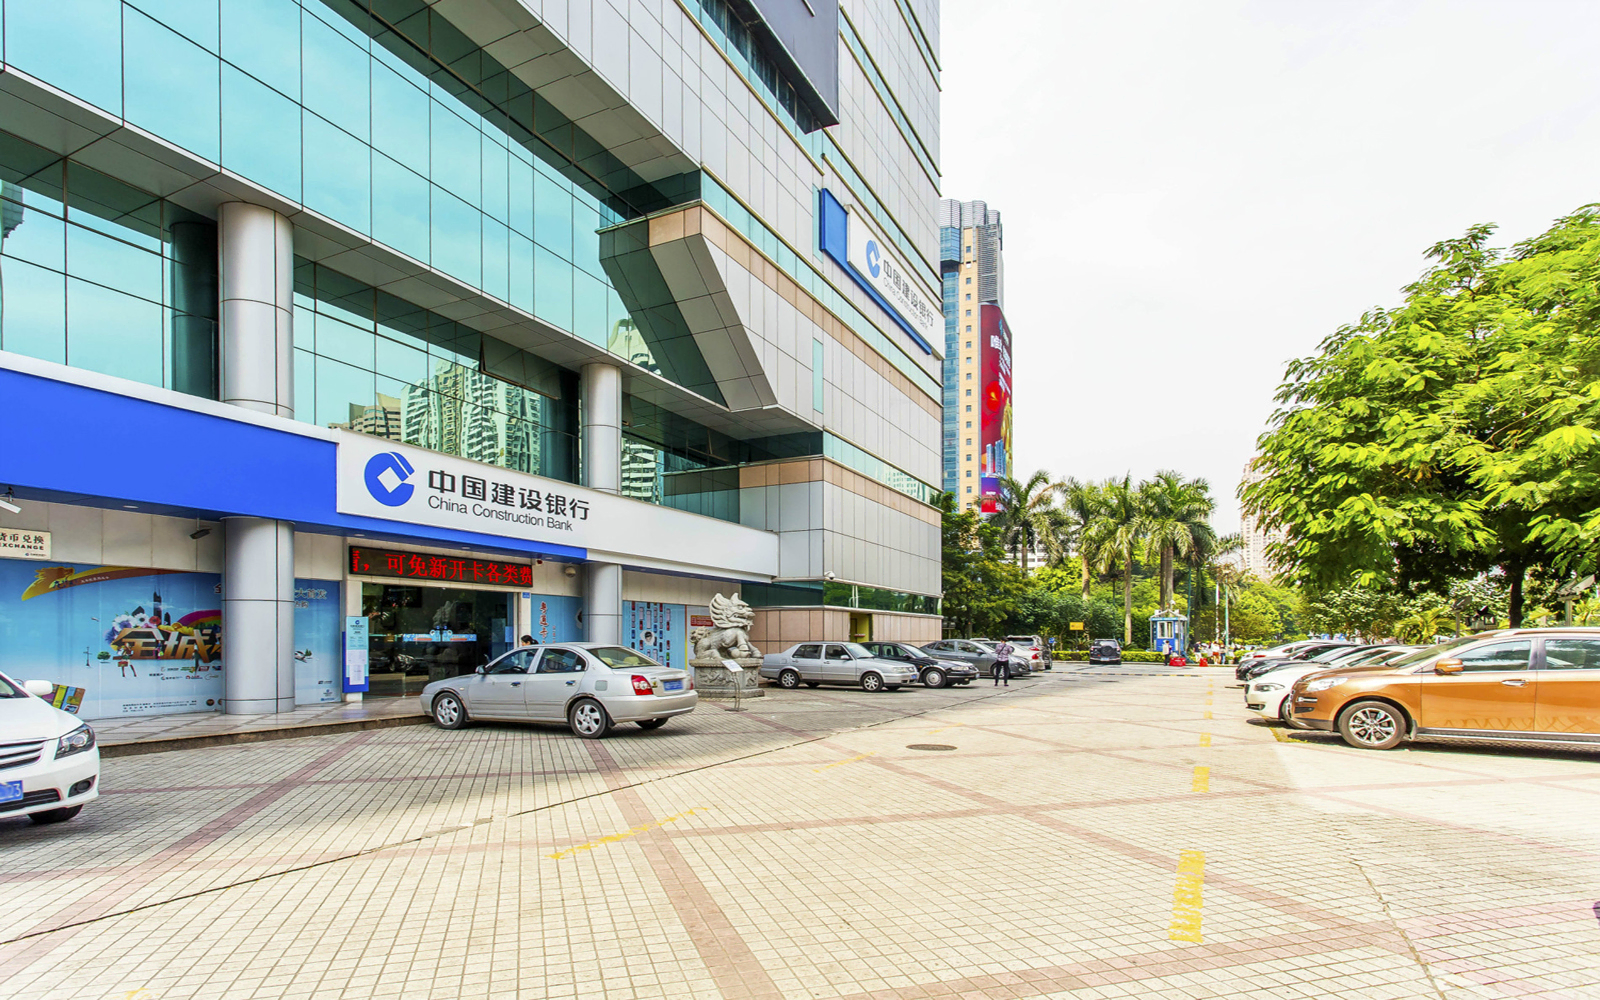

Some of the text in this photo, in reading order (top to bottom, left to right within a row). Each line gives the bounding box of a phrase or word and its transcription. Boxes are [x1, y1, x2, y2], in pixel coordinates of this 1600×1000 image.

[883, 259, 934, 328] 中国建设银行
[428, 469, 590, 521] 中国建设银行
[428, 495, 573, 532] China Construction Bank
[0, 542, 44, 550] XCHANGE
